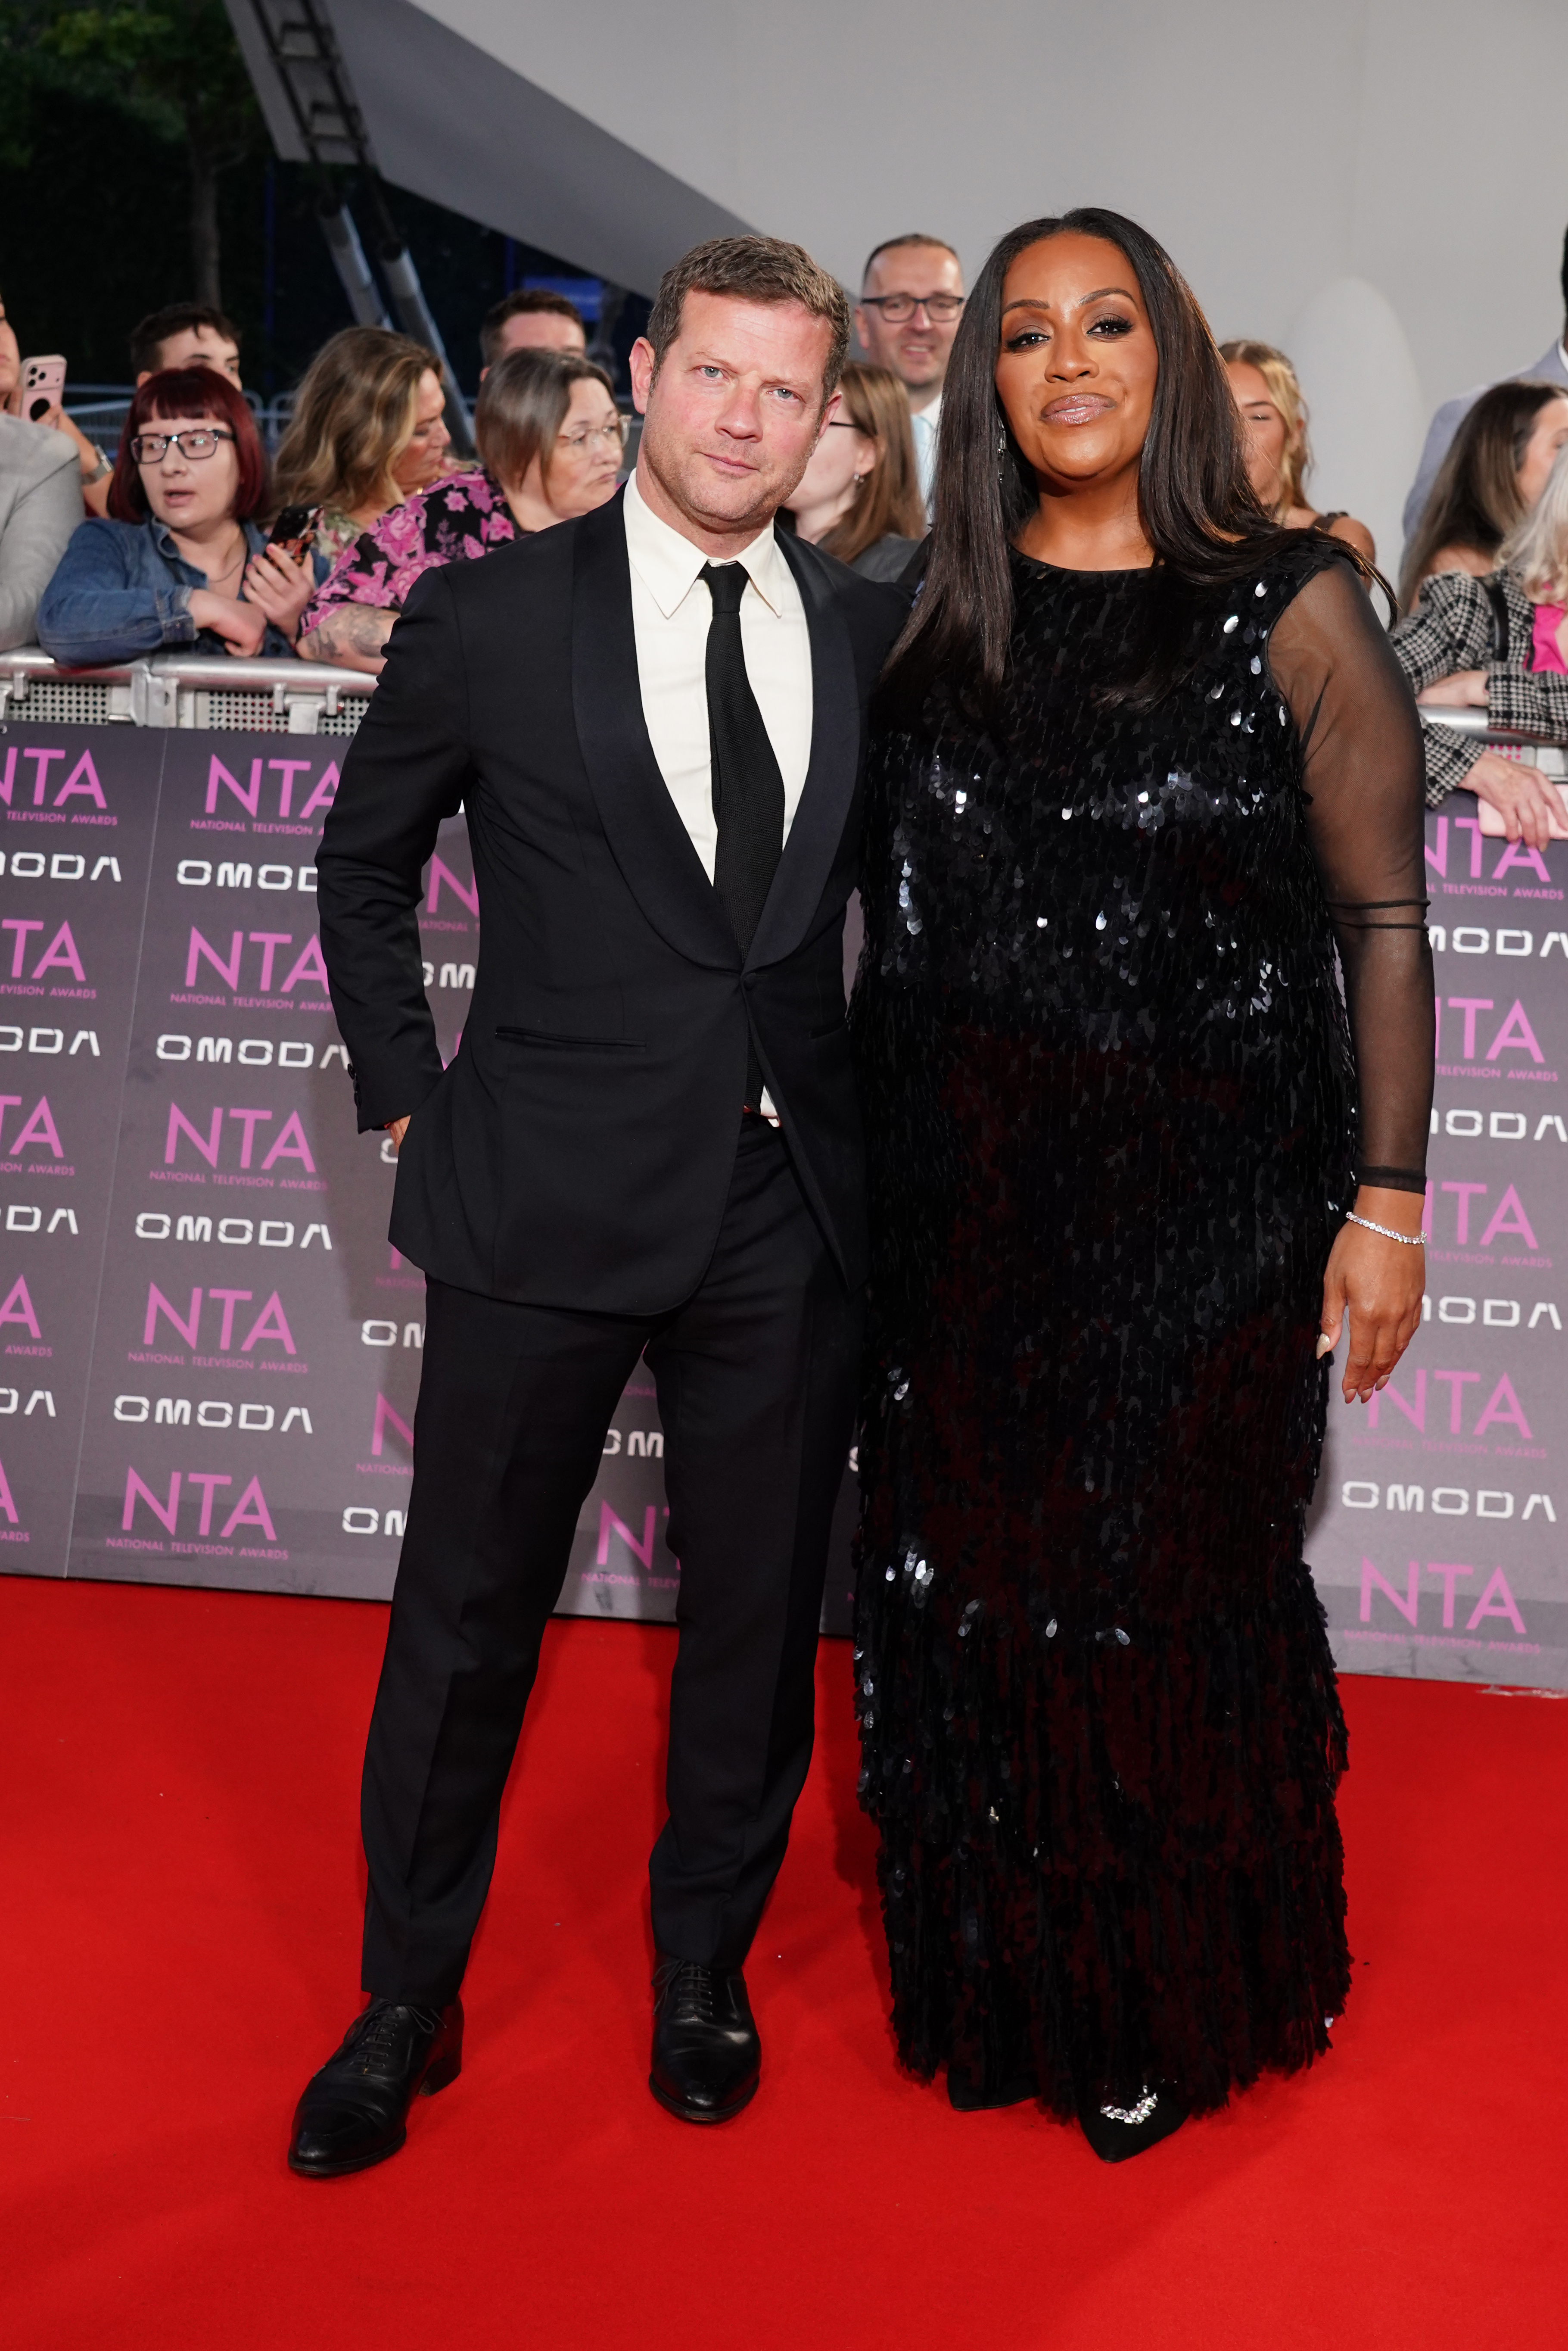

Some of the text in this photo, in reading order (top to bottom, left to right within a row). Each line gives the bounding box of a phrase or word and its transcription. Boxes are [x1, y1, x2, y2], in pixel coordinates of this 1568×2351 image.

[7, 811, 117, 825] TELEVISION AWARDS
[190, 820, 246, 831] NATIONAL
[253, 823, 312, 835] TELEVISION
[0, 851, 122, 882] ODA
[177, 859, 318, 892] OMOD
[1443, 884, 1507, 896] TELEVISION
[1514, 888, 1563, 900] AWARDS
[1, 919, 86, 982] TA
[1428, 925, 1568, 958] ODA
[185, 926, 330, 995] NTA
[0, 985, 96, 998] EVISION AWARDS
[171, 994, 333, 1011] NATIONAL TELEVISION AWAR
[0, 1025, 100, 1057] ODA
[1434, 996, 1545, 1063] TA
[156, 1034, 350, 1070] OMODA
[1436, 1066, 1558, 1081] TELEVISION AWARDS
[165, 1103, 316, 1173] NTA
[1430, 1108, 1568, 1143] ODA
[28, 1165, 75, 1176] AWARDS
[150, 1171, 326, 1190] NATIONAL TELEVISION AWARDS
[1421, 1180, 1538, 1250] TA
[135, 1213, 333, 1250] OMODA
[1429, 1250, 1552, 1267] TELEVISION AWARDS
[143, 1282, 297, 1355] NTA
[1422, 1294, 1562, 1330] ODA
[5, 1345, 52, 1356] AWARDS
[128, 1353, 308, 1373] NATIONAL TELEVISION AWARDS
[113, 1395, 313, 1434] OMODA
[1367, 1368, 1533, 1440] NTA
[1423, 1441, 1487, 1454] TELEVISION
[1496, 1446, 1546, 1458] AWARDS
[122, 1467, 277, 1541] NTA
[1341, 1481, 1556, 1522] OMODA
[0, 1531, 29, 1542] ARDS
[107, 1538, 288, 1559] NATIONAL TELEVISION AWARDS
[582, 1573, 639, 1585] NATIONAL
[1359, 1556, 1527, 1635] NTA
[1344, 1630, 1540, 1653] NATIONAL TELEVISION AWARDS
